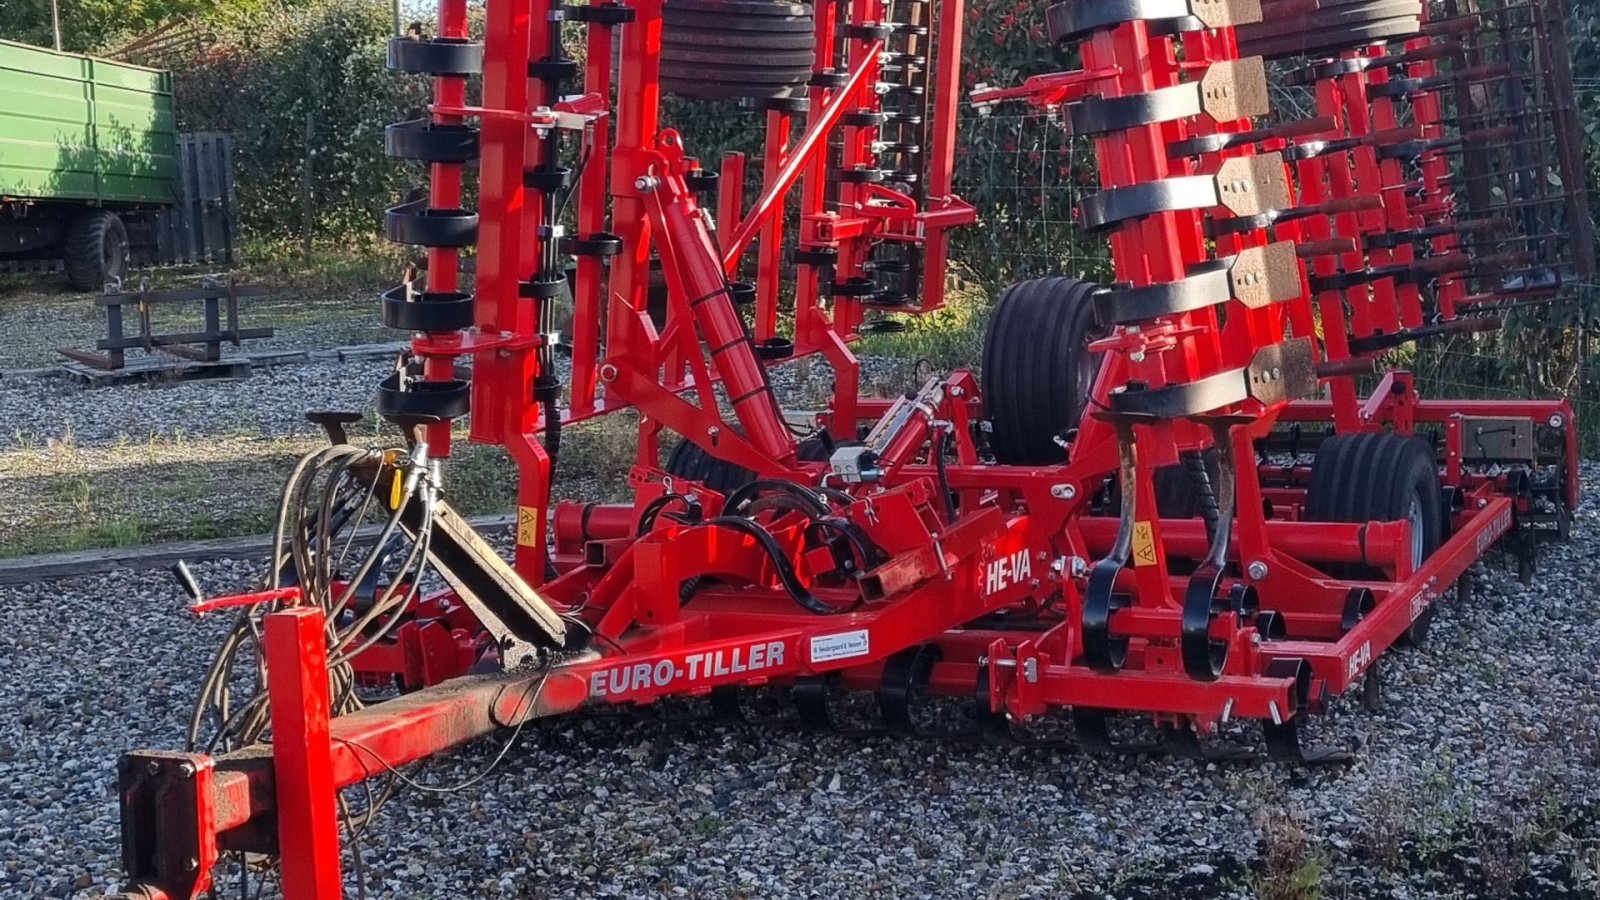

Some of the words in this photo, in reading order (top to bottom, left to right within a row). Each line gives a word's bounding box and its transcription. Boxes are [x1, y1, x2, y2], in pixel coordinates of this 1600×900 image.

[986, 548, 1031, 595] HE-VA
[590, 641, 785, 697] EURO-TILLER
[1349, 640, 1371, 679] HE-VA
